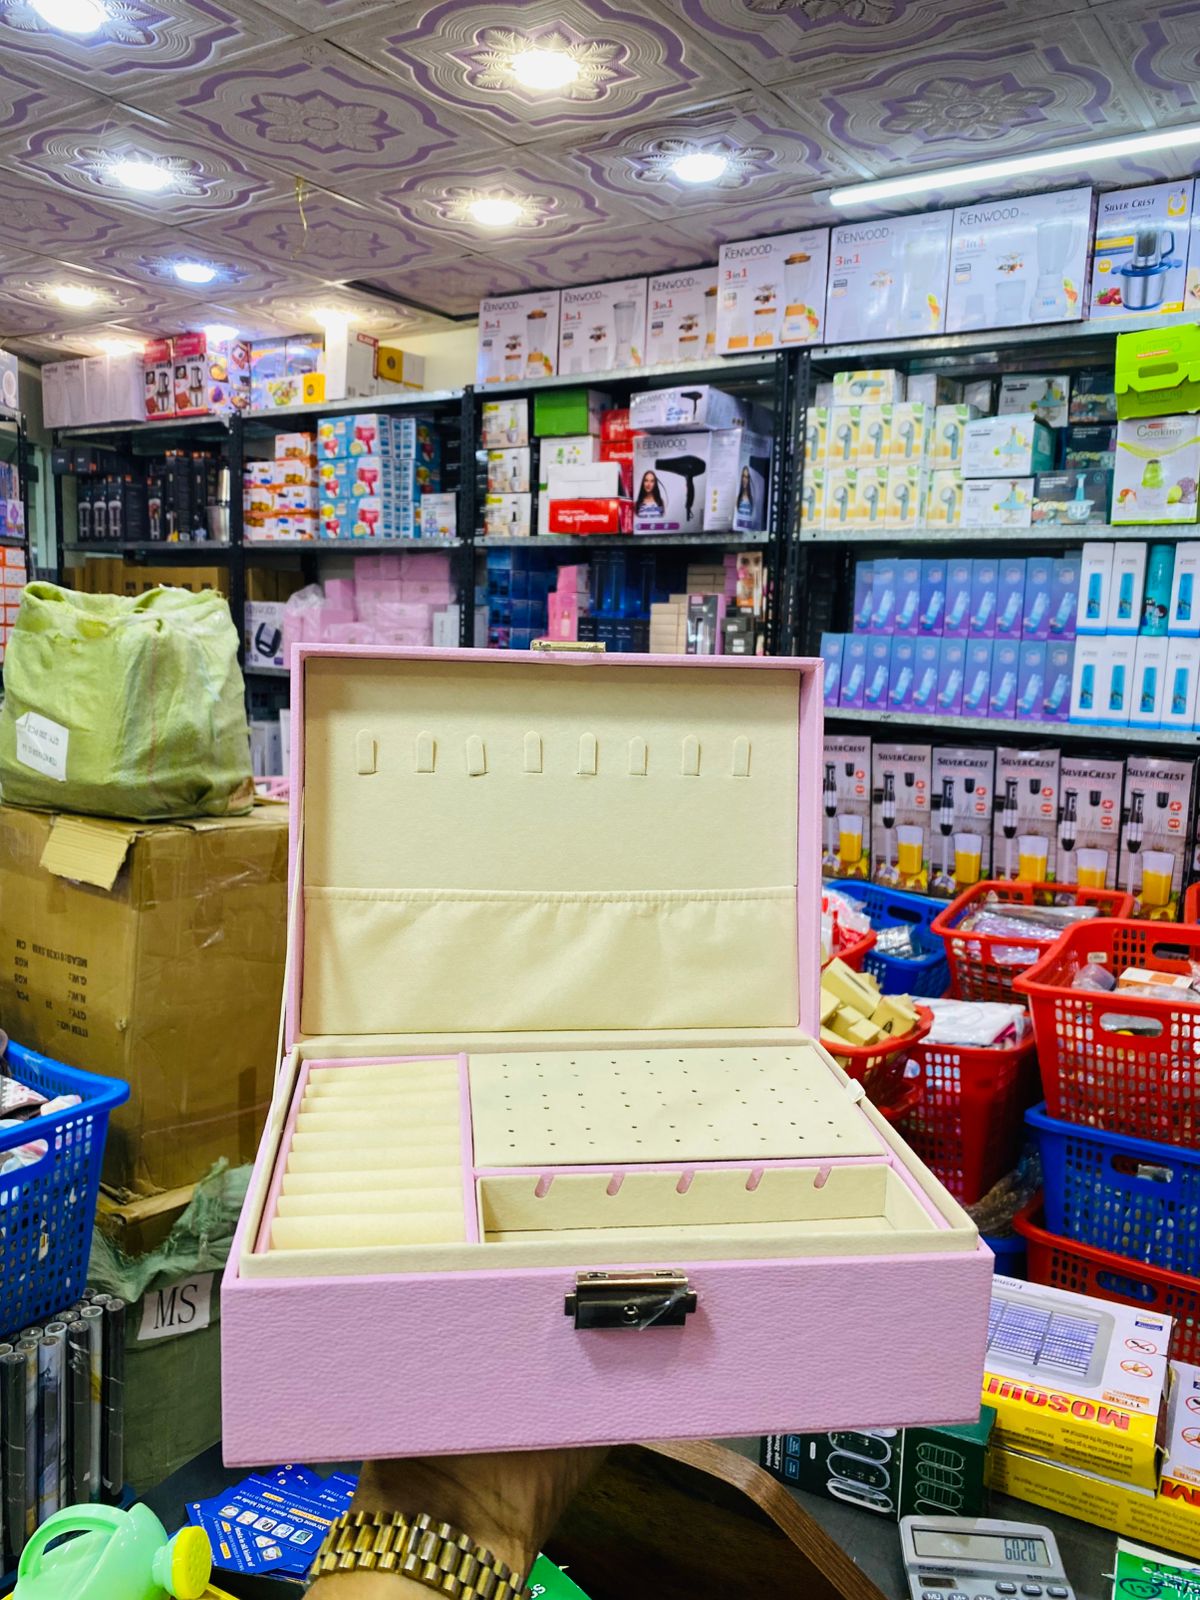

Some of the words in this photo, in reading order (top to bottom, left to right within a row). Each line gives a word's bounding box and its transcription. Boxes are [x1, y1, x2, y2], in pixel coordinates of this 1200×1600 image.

[1104, 200, 1128, 212] SILVER
[1131, 198, 1155, 208] CREST
[960, 208, 1019, 226] KENWOOD
[837, 228, 889, 244] KENWOOD
[724, 244, 772, 260] KENWOOD
[652, 278, 694, 291] KENWOOD
[564, 291, 600, 303] KENWOOD
[483, 301, 518, 312] KENWOOD
[153, 1284, 198, 1330] MS
[982, 1377, 1130, 1431] MOSQUI
[1004, 1538, 1036, 1562] 6020
